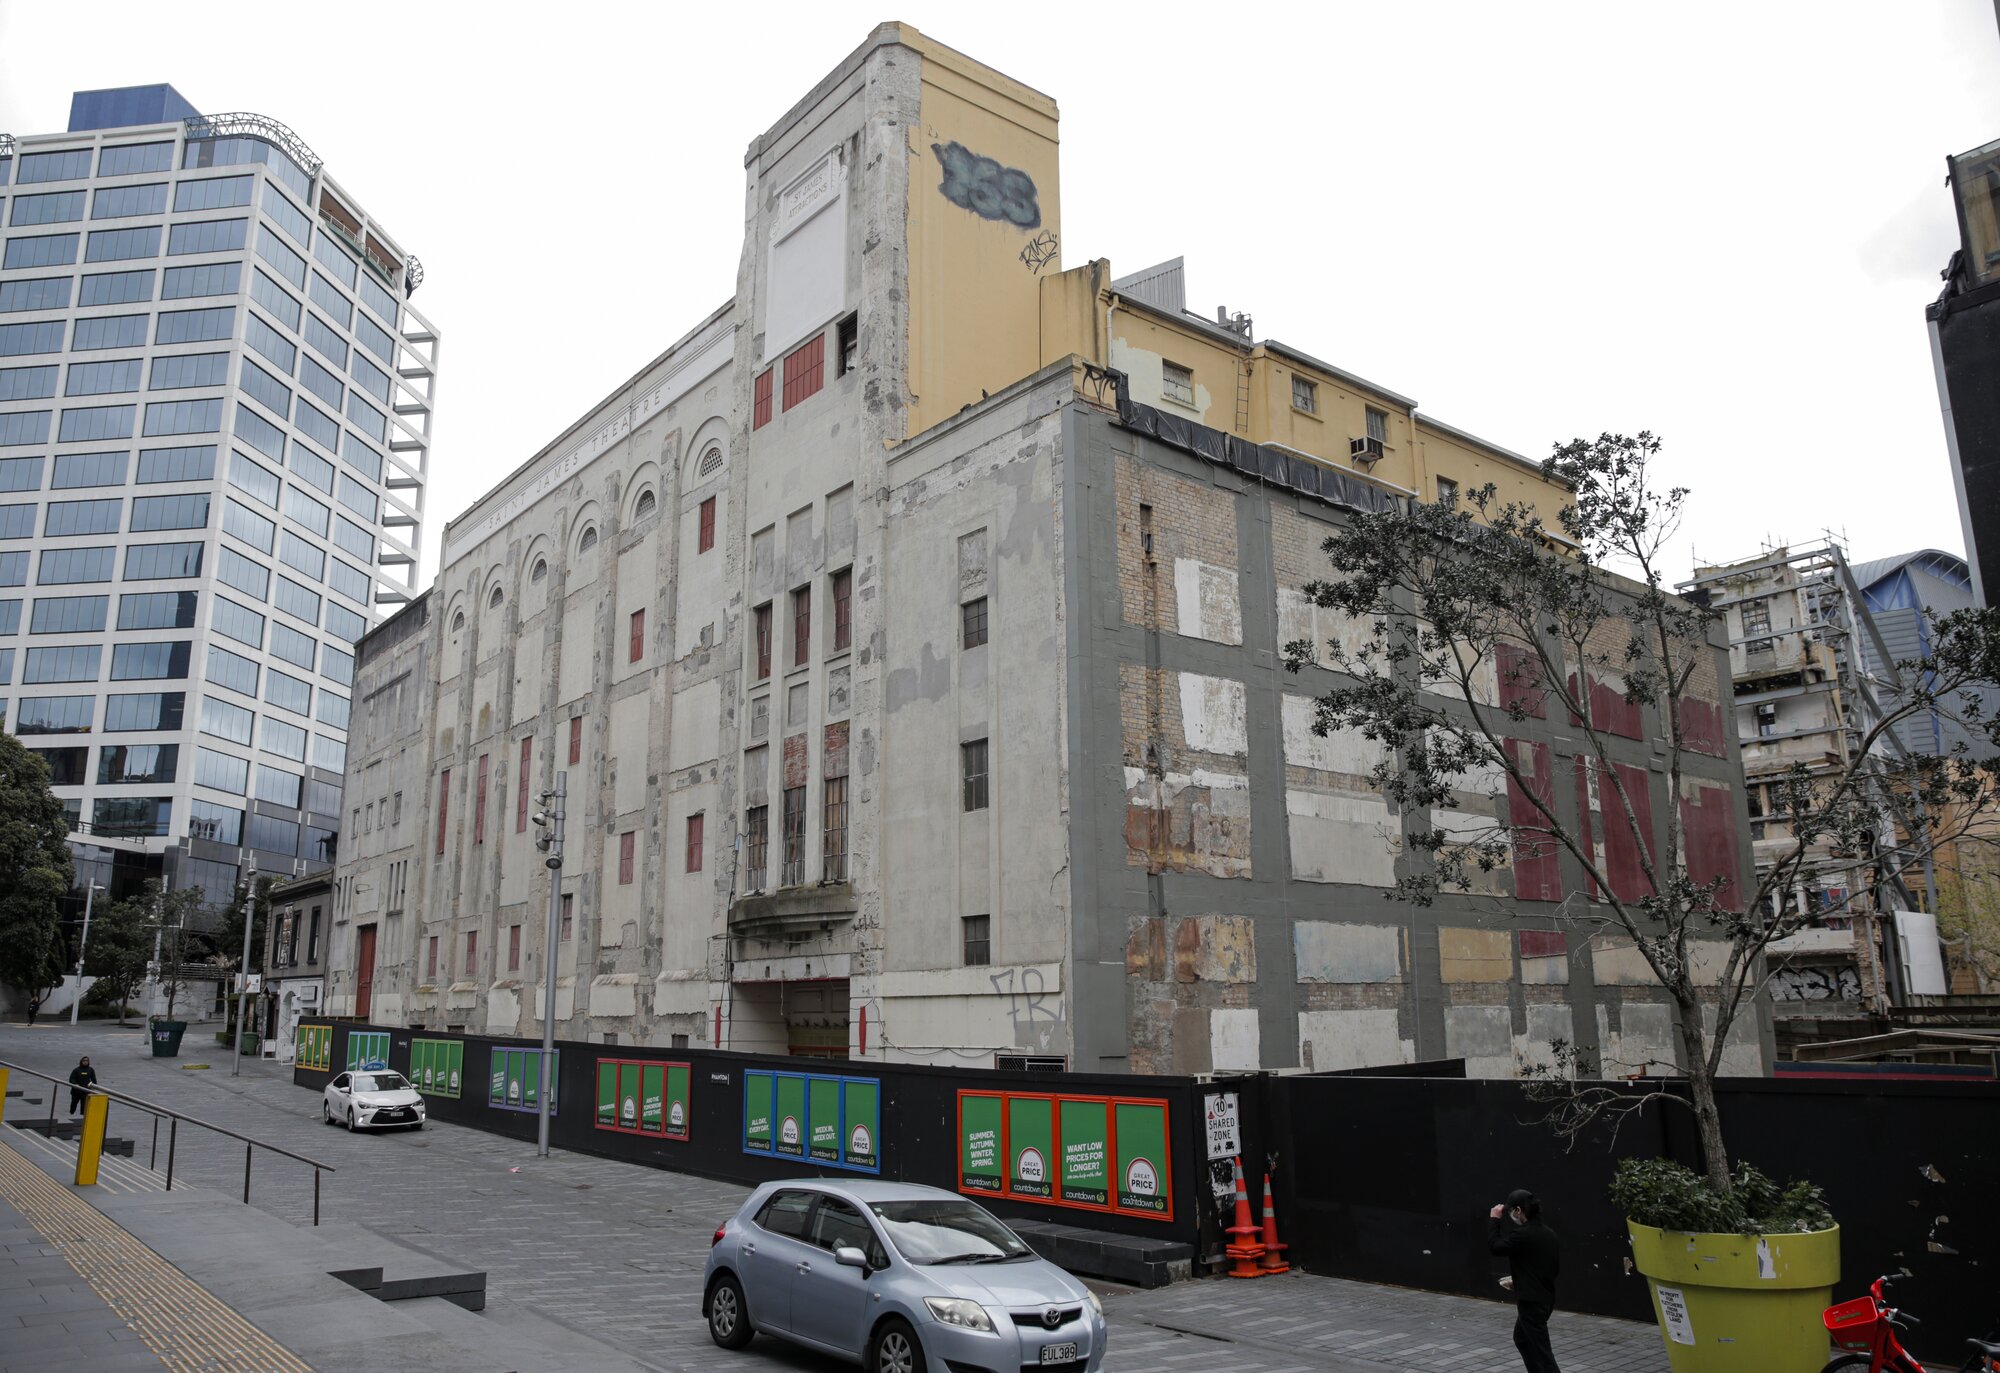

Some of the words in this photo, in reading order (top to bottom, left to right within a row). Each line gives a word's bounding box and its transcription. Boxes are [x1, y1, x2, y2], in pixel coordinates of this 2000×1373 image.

[489, 491, 526, 529] SAINT
[536, 452, 579, 493] JAMES
[591, 389, 661, 452] THEATRE
[1215, 1100, 1225, 1112] 10
[1208, 1117, 1235, 1130] SHARED
[784, 1132, 796, 1140] PRICE
[1213, 1129, 1231, 1141] ZONE
[854, 1141, 868, 1150] PRICE
[1067, 1143, 1086, 1153] WANT
[1087, 1141, 1103, 1150] LOW
[1066, 1152, 1089, 1163] PRICES
[1089, 1151, 1104, 1160] FOR
[971, 1158, 994, 1168] SPRING.
[1069, 1161, 1100, 1172] LONGER?
[1022, 1167, 1041, 1176] PRICE
[966, 1177, 992, 1187] countdown
[1131, 1180, 1153, 1189] PRICE
[1013, 1184, 1041, 1193] countdown
[1066, 1191, 1096, 1201] countdown
[1122, 1197, 1154, 1208] countdown
[1665, 1309, 1683, 1319] STOLEN
